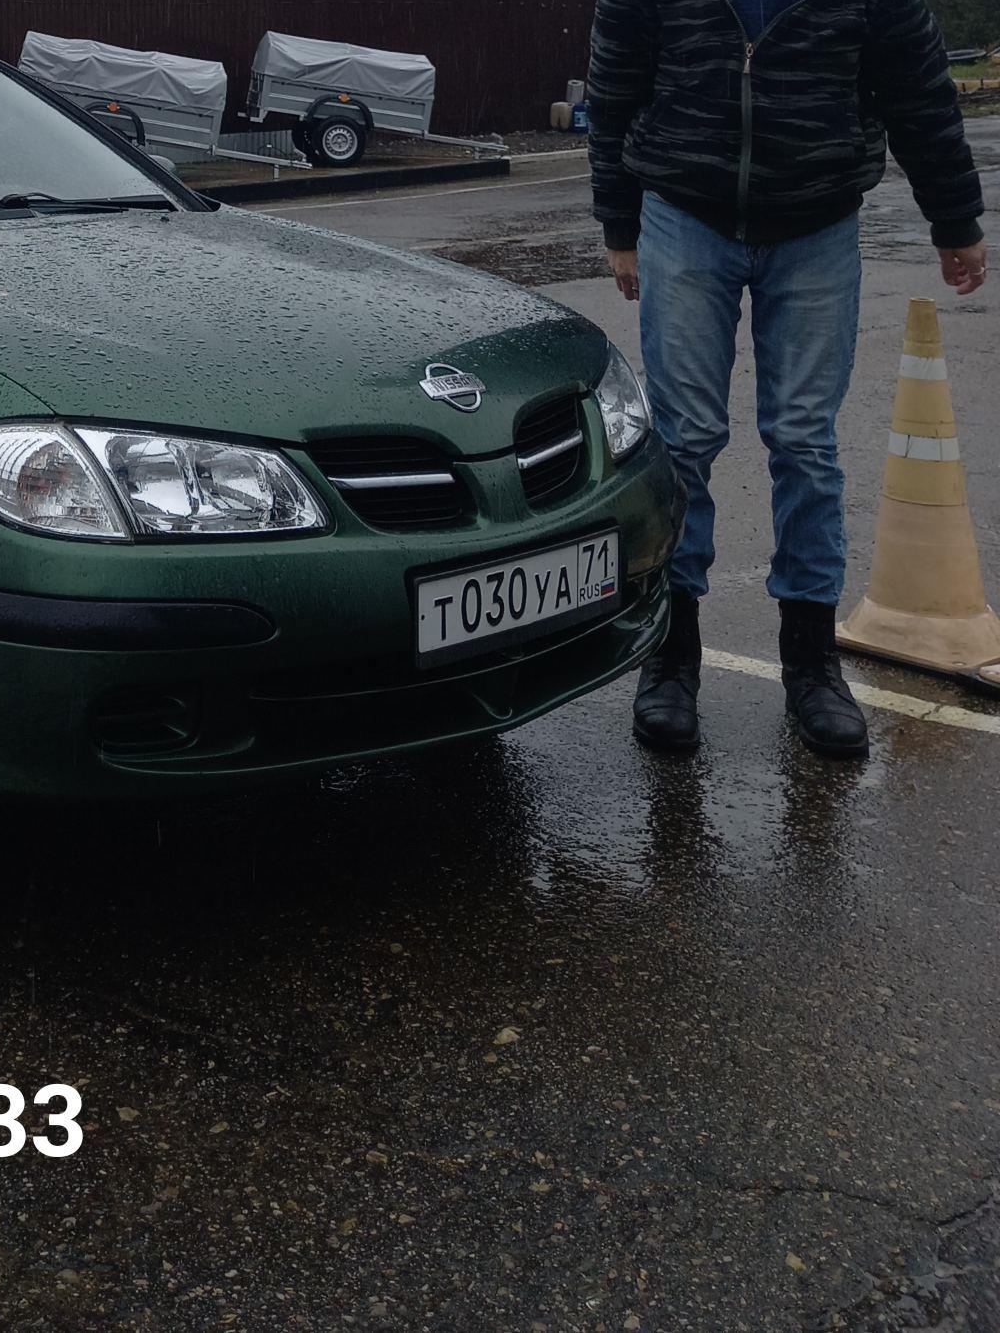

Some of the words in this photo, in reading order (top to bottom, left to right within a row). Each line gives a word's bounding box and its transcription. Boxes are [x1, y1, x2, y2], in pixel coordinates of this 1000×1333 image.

[433, 566, 572, 642] Т030УА
[582, 539, 609, 585] 71
[579, 583, 600, 603] RUS
